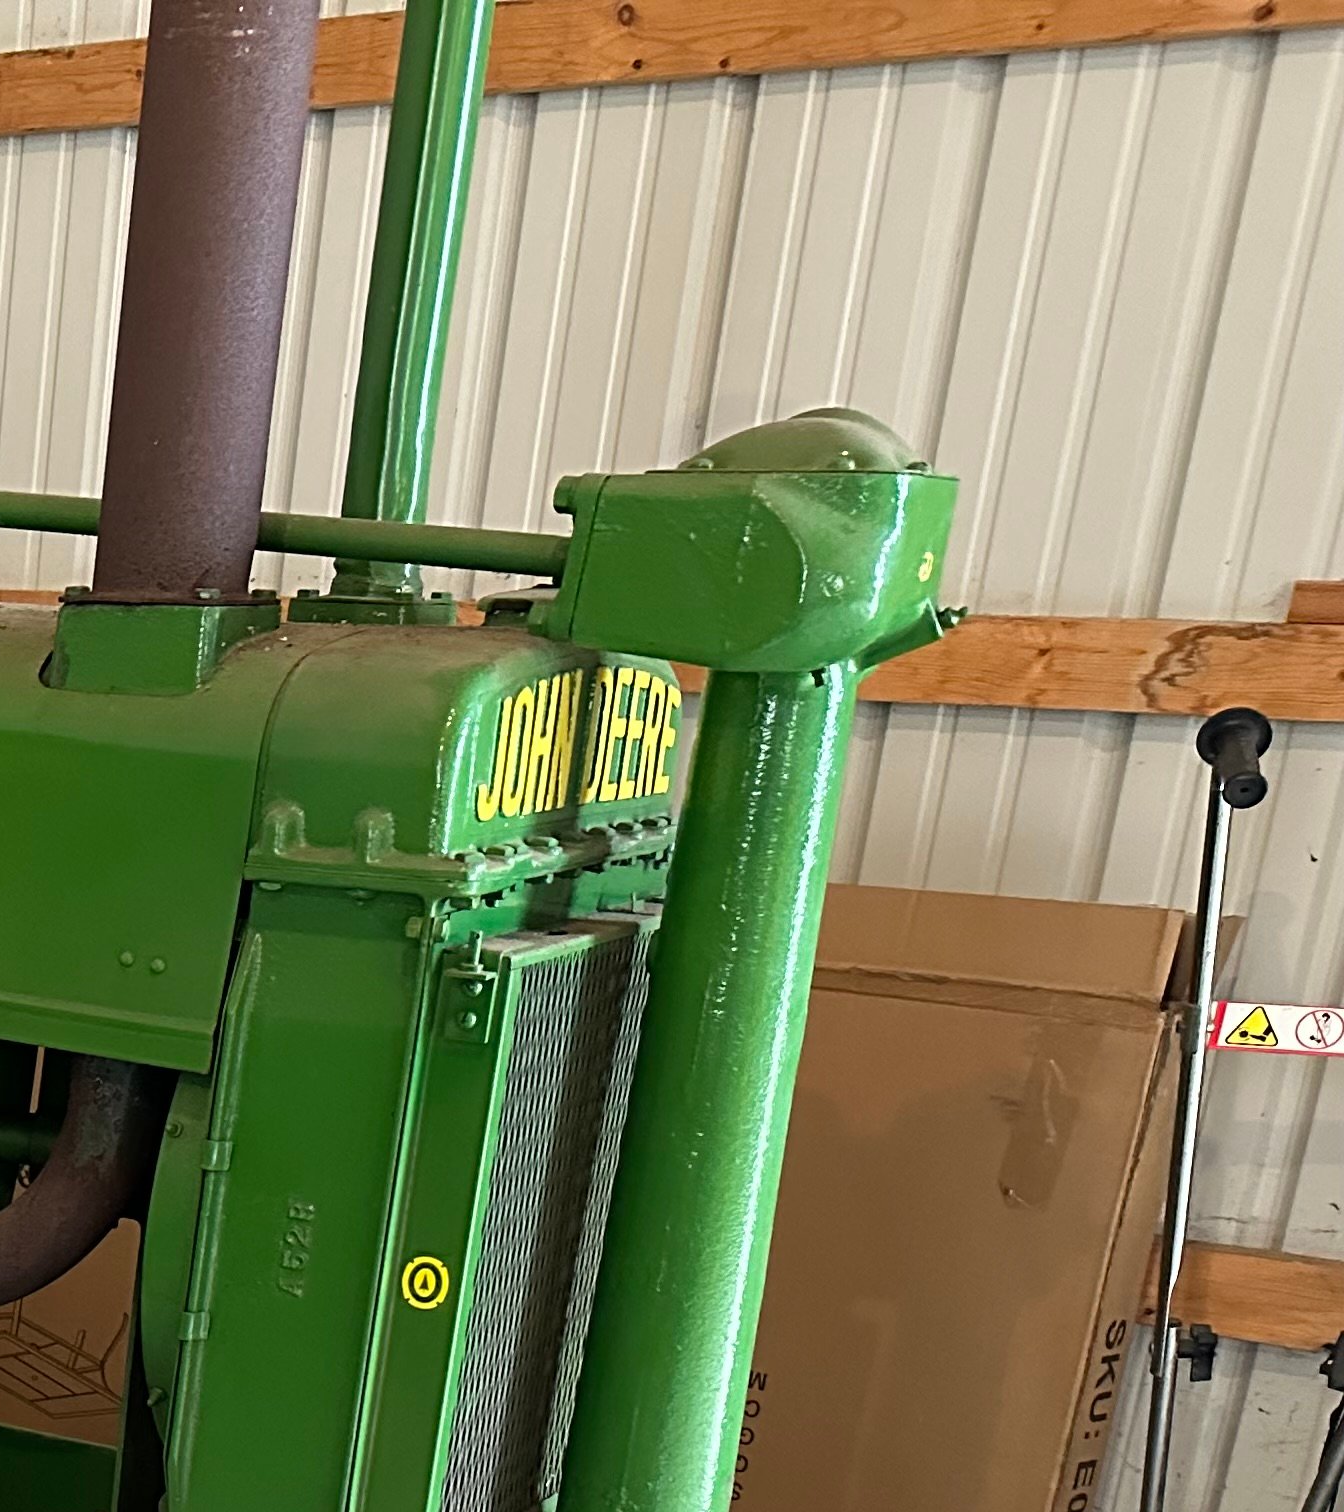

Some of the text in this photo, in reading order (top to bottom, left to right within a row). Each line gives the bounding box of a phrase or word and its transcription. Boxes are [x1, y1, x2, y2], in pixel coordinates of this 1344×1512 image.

[476, 665, 682, 822] JOHN DEERE
[1083, 1318, 1126, 1440] SKU:
